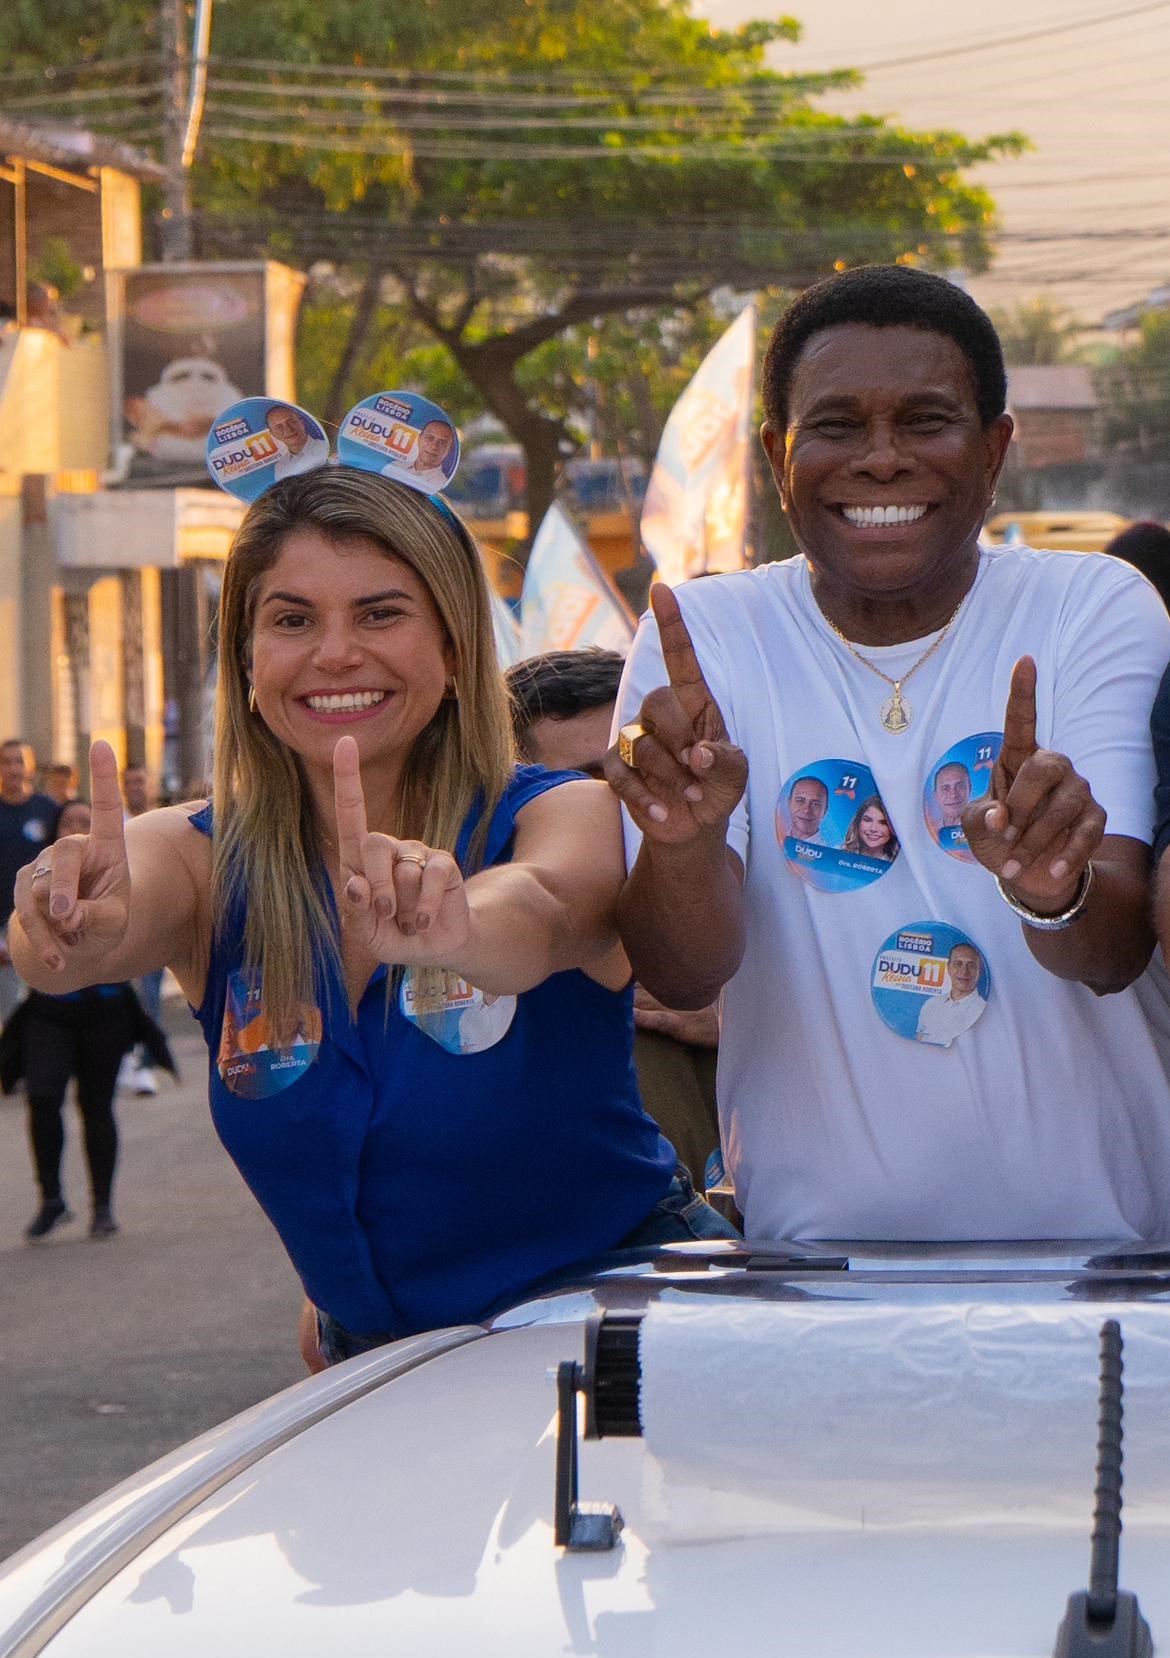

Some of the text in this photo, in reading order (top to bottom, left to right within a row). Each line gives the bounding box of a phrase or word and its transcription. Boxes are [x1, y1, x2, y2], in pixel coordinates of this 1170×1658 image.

[376, 405, 408, 420] LISBOA
[218, 428, 250, 443] LISBOA
[350, 415, 412, 449] DUDU 11
[213, 437, 272, 470] DUDU 11
[978, 746, 992, 760] 11
[842, 775, 857, 789] 11
[951, 831, 965, 840] DU
[795, 845, 822, 859] DUDU
[852, 861, 883, 875] ROBERTA
[898, 943, 931, 953] LISBOA
[899, 936, 932, 946] ROGÉRIO
[879, 961, 940, 983] DUDU 11
[227, 1063, 250, 1077] DUDU
[270, 1060, 307, 1071] ROBERTA
